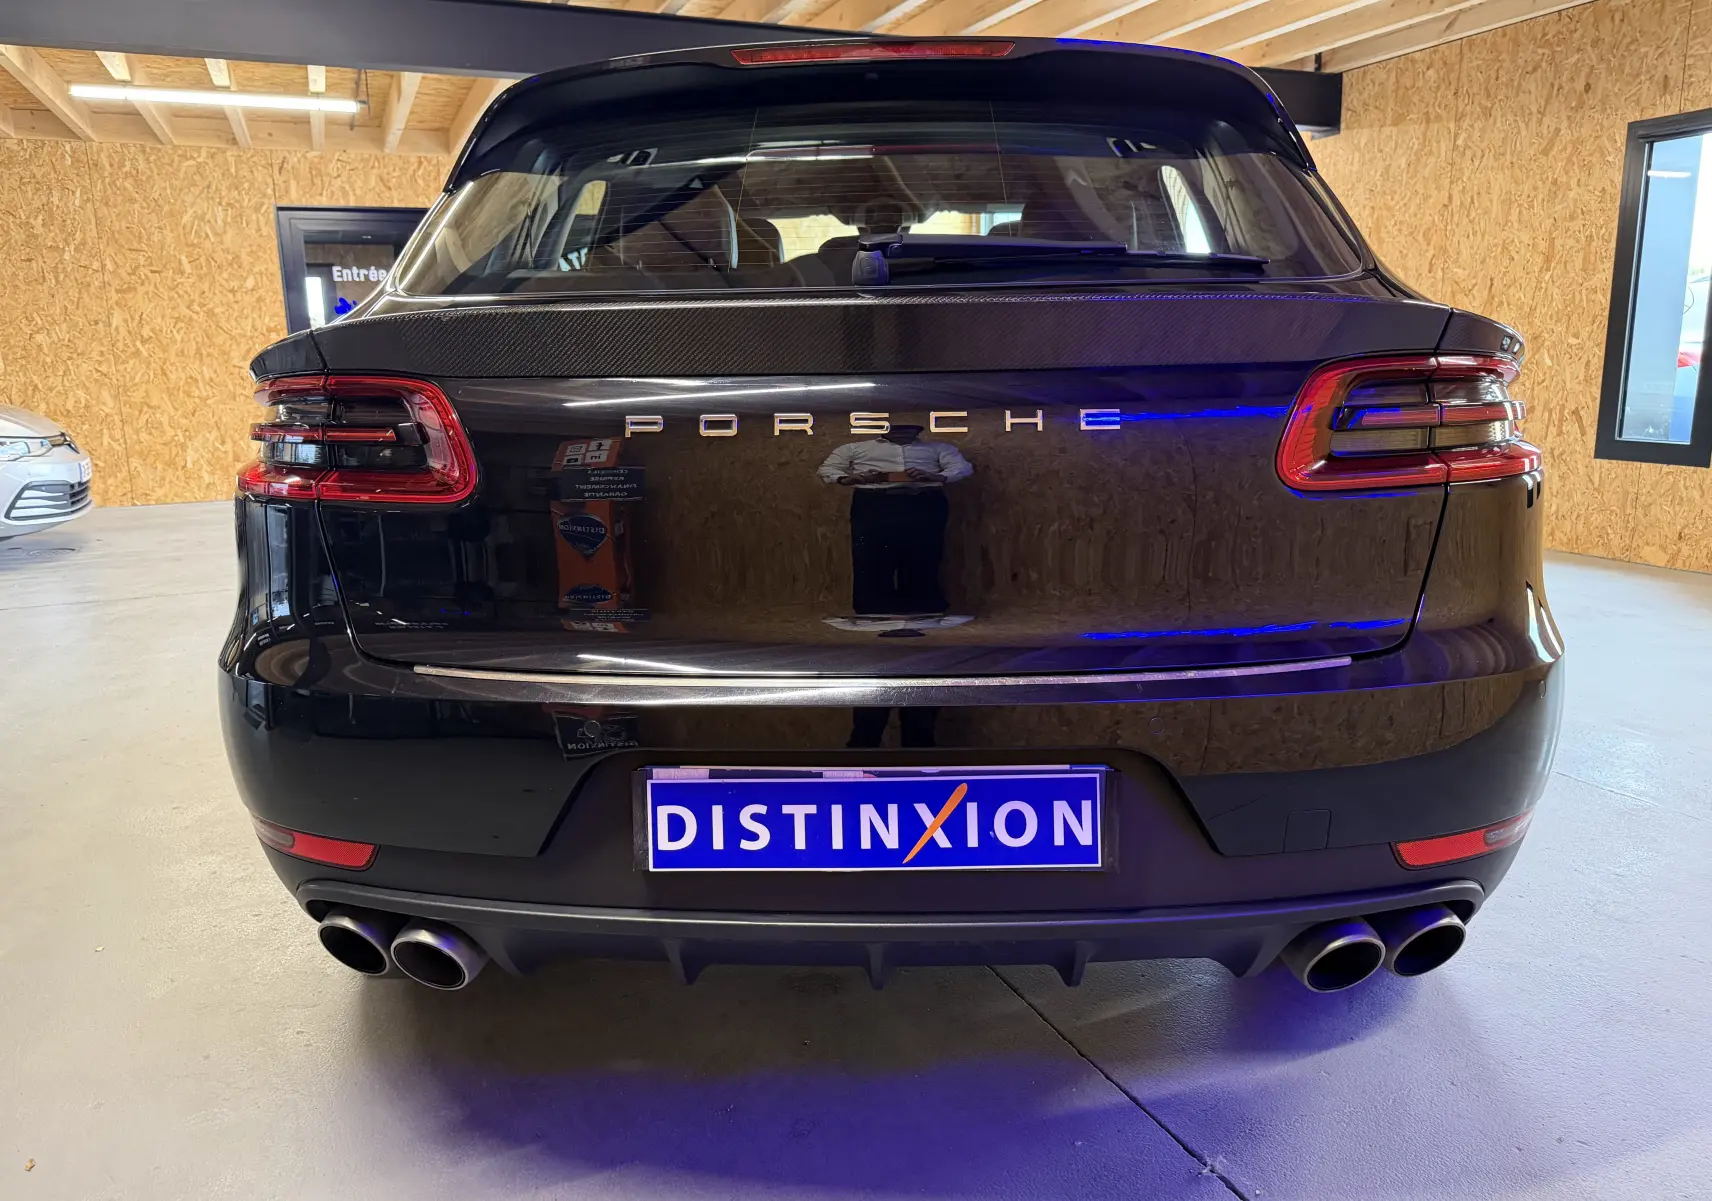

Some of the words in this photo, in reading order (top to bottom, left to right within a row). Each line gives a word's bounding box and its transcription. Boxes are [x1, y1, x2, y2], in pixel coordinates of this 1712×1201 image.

[332, 265, 388, 282] Entrée
[624, 407, 1121, 438] PORSCHE
[656, 783, 1094, 864] DISTINXION
